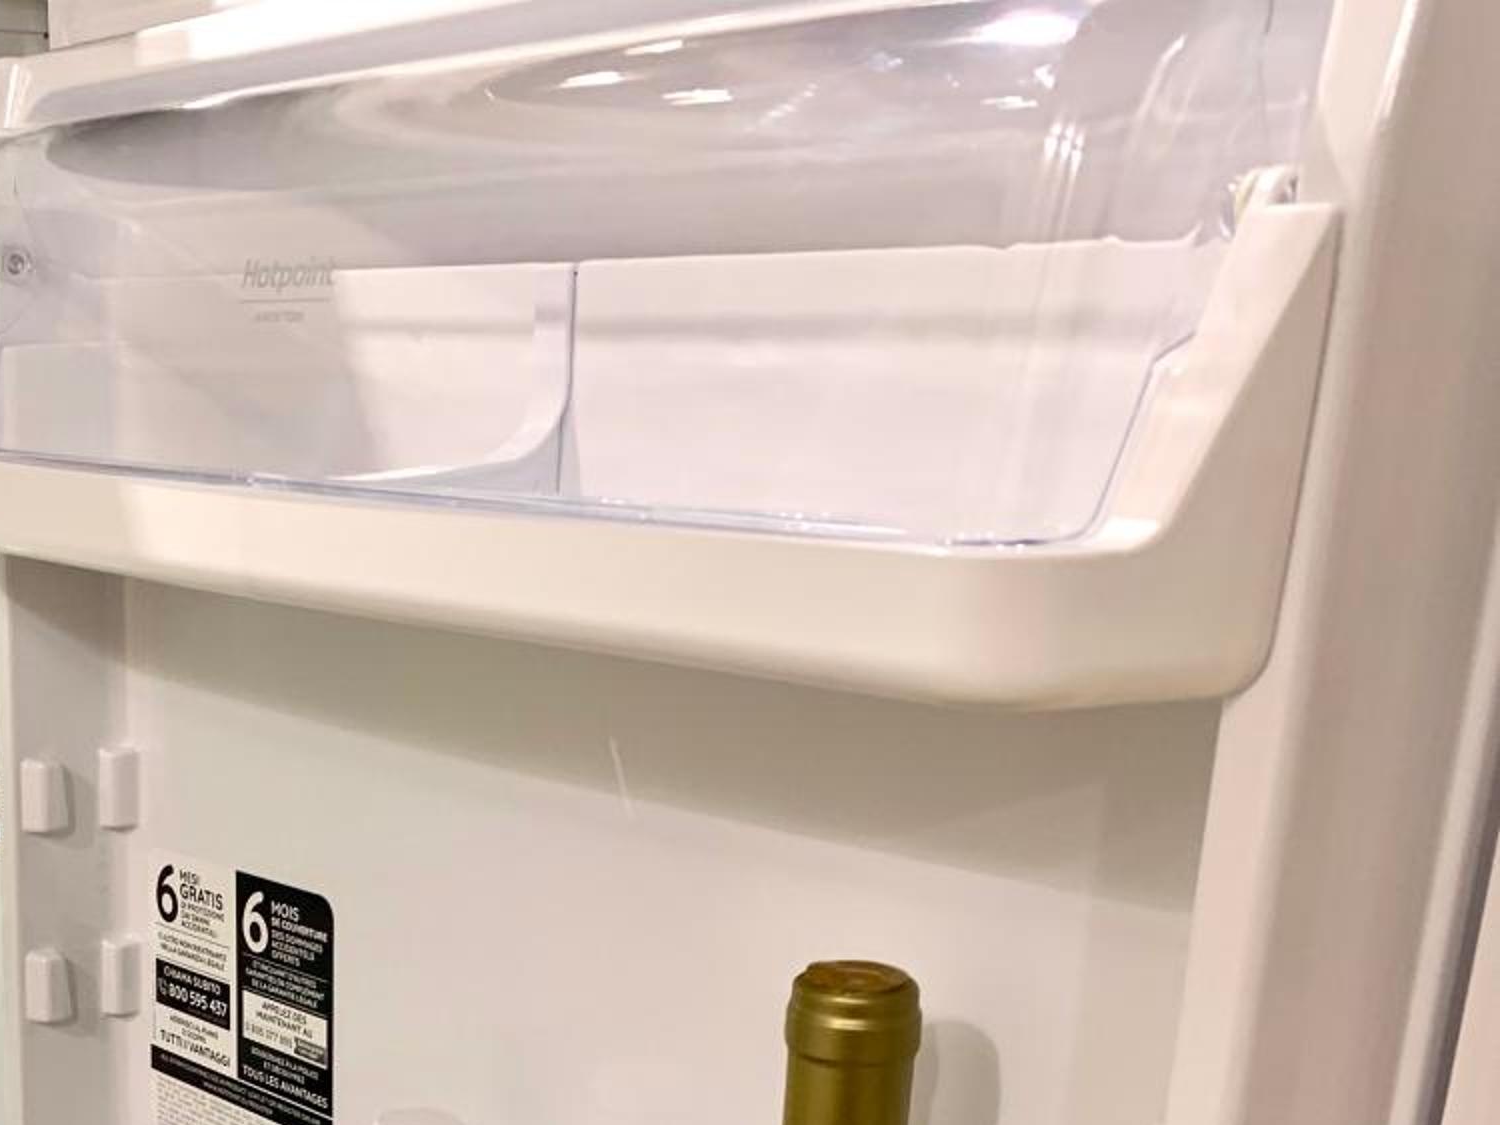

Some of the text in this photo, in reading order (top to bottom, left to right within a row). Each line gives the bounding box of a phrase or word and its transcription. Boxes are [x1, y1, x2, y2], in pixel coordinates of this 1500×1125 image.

[242, 257, 334, 294] Hotpoint
[156, 864, 178, 922] 6
[180, 884, 223, 911] GRATIS
[243, 890, 268, 953] 6
[271, 900, 299, 922] MOIS
[164, 965, 221, 996] CHIAMA SUBITO
[169, 982, 189, 1003] 800
[189, 1041, 230, 1068] VANTAGGI
[243, 1065, 264, 1083] TOUS
[265, 1073, 280, 1090] LES
[281, 1080, 328, 1109] AVANTAGES
